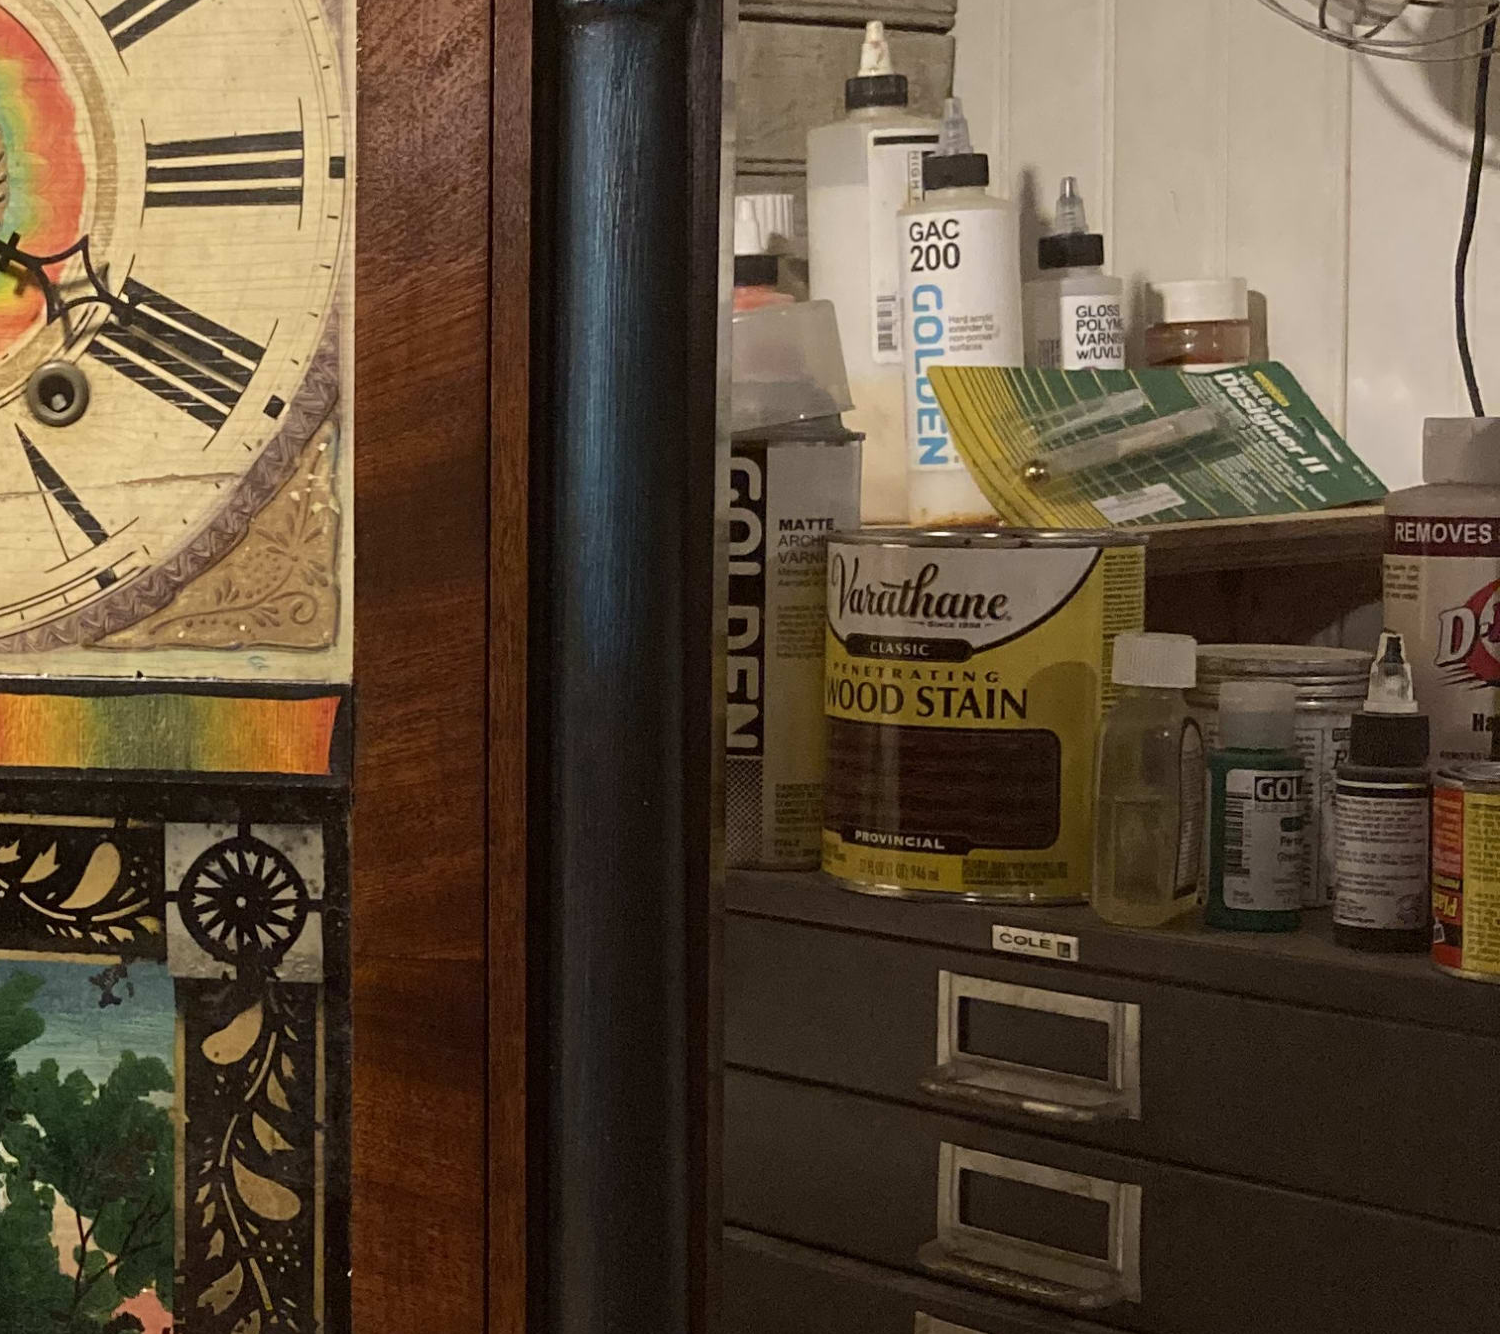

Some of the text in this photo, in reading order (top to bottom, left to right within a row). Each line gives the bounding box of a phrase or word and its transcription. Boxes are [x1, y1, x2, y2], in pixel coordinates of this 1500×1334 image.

[909, 218, 960, 243] GAC
[909, 242, 961, 272] 200
[1076, 304, 1120, 318] GLOSS
[912, 284, 949, 465] GOLDEN
[1213, 372, 1306, 455] Designer
[778, 518, 835, 532] MATTE
[1395, 522, 1492, 544] REMOVES
[832, 551, 1010, 621] Varathane
[869, 641, 930, 656] CLASSIC
[833, 661, 1000, 683] PENETRATING
[827, 678, 1029, 720] WOOD STAIN
[854, 829, 946, 851] PROVINCIAL
[999, 932, 1052, 950] COLE
